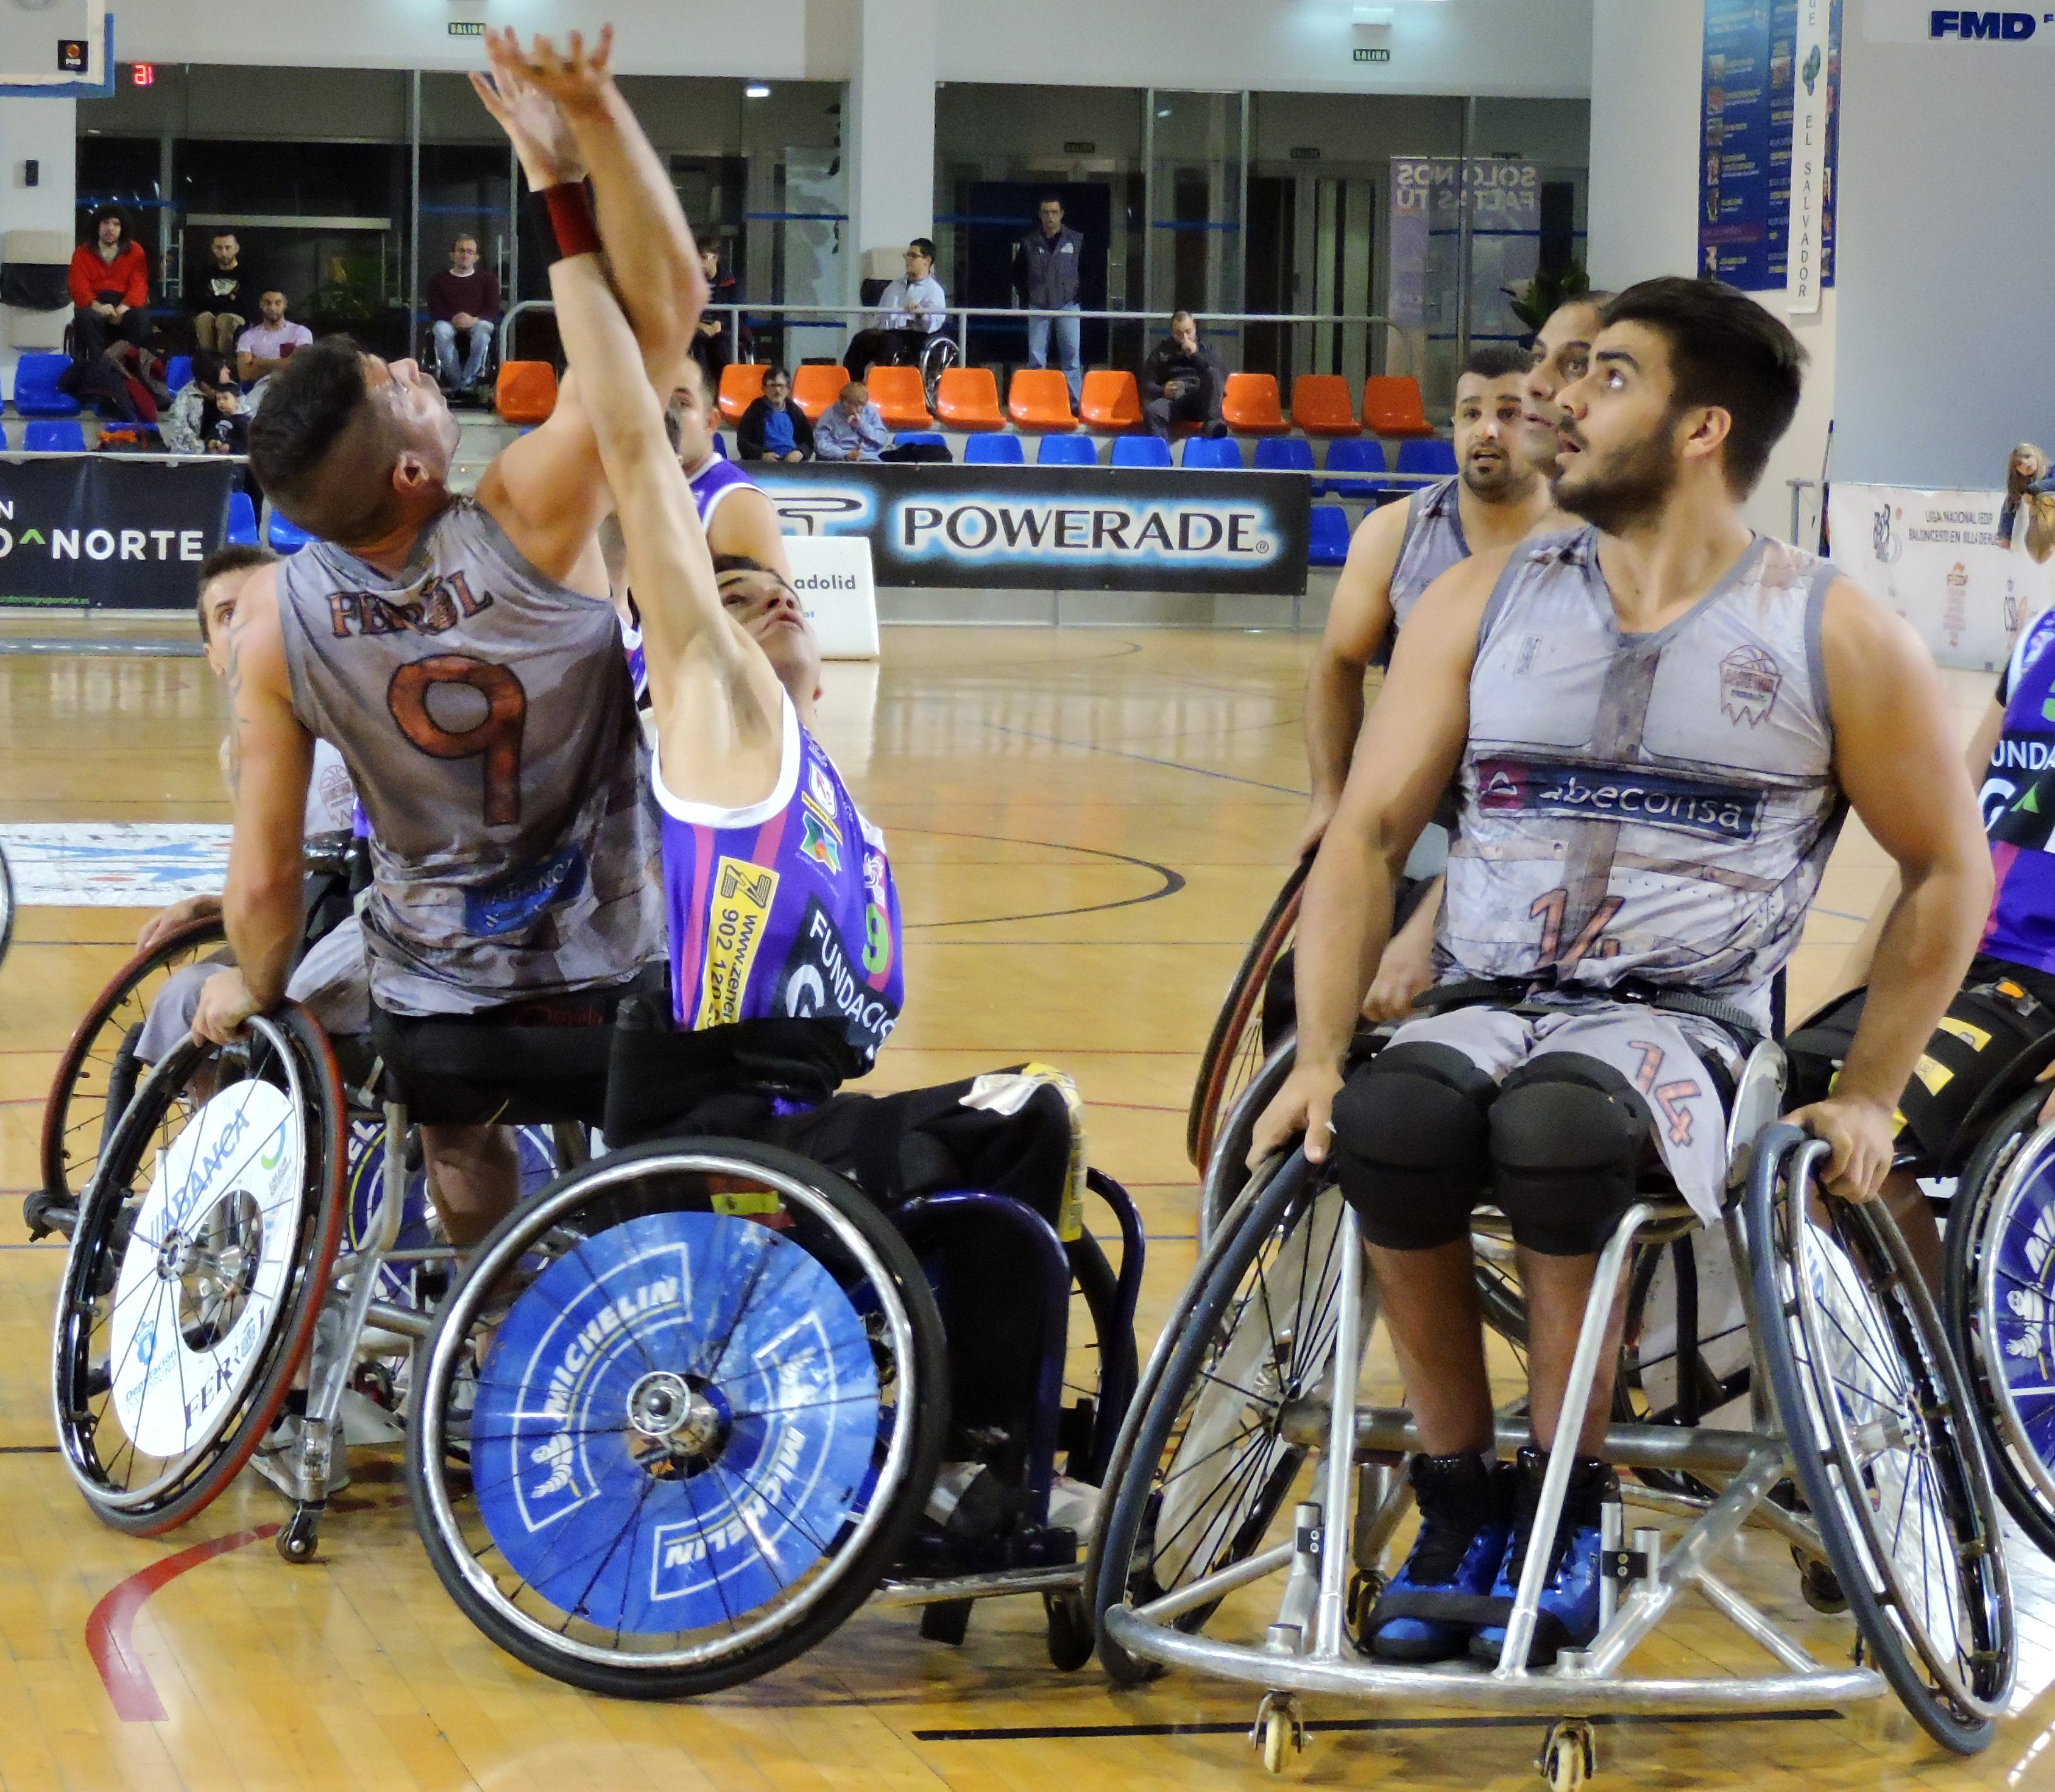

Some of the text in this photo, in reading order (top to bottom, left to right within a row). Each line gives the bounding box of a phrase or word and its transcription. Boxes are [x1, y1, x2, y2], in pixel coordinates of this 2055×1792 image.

[1931, 10, 2036, 40] FMD
[1799, 162, 1811, 297] SALVADOR
[52, 529, 203, 561] NORTE
[387, 654, 527, 826] 9
[716, 909, 739, 951] 902
[861, 902, 890, 974] 9
[1626, 1039, 1702, 1147] 14
[546, 1275, 679, 1422] MICHELIN
[663, 1428, 807, 1569] MICHELIN
